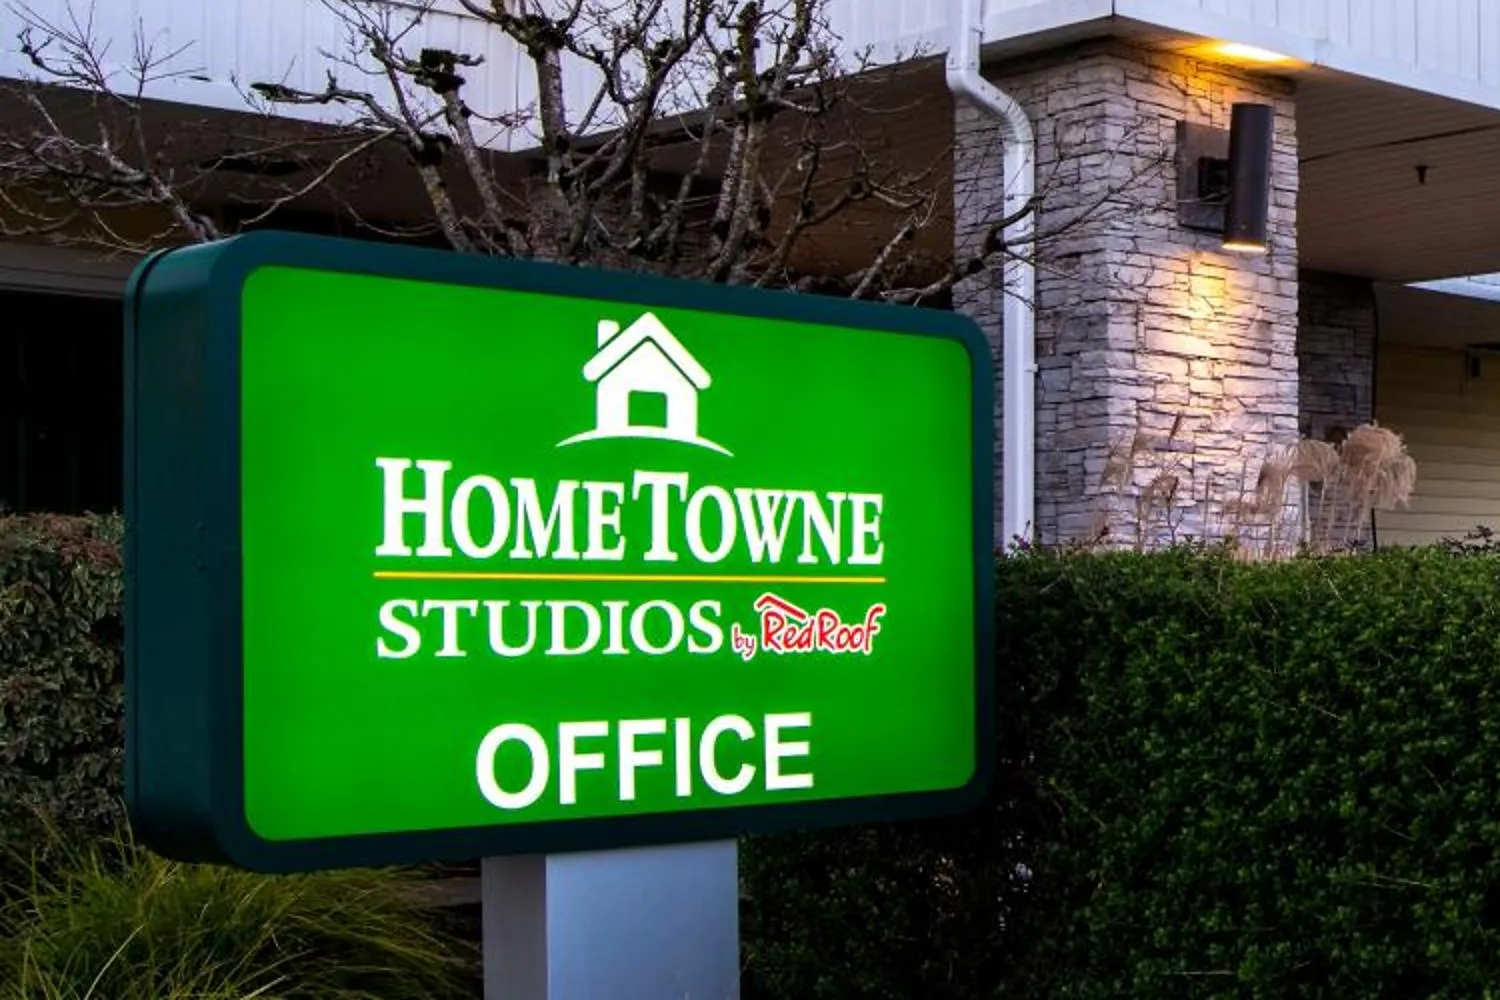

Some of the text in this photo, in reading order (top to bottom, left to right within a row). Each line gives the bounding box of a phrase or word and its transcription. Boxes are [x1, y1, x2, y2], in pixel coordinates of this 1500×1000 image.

[376, 599, 724, 659] STUDIOS
[731, 622, 757, 661] by
[475, 712, 814, 809] OFFICE
